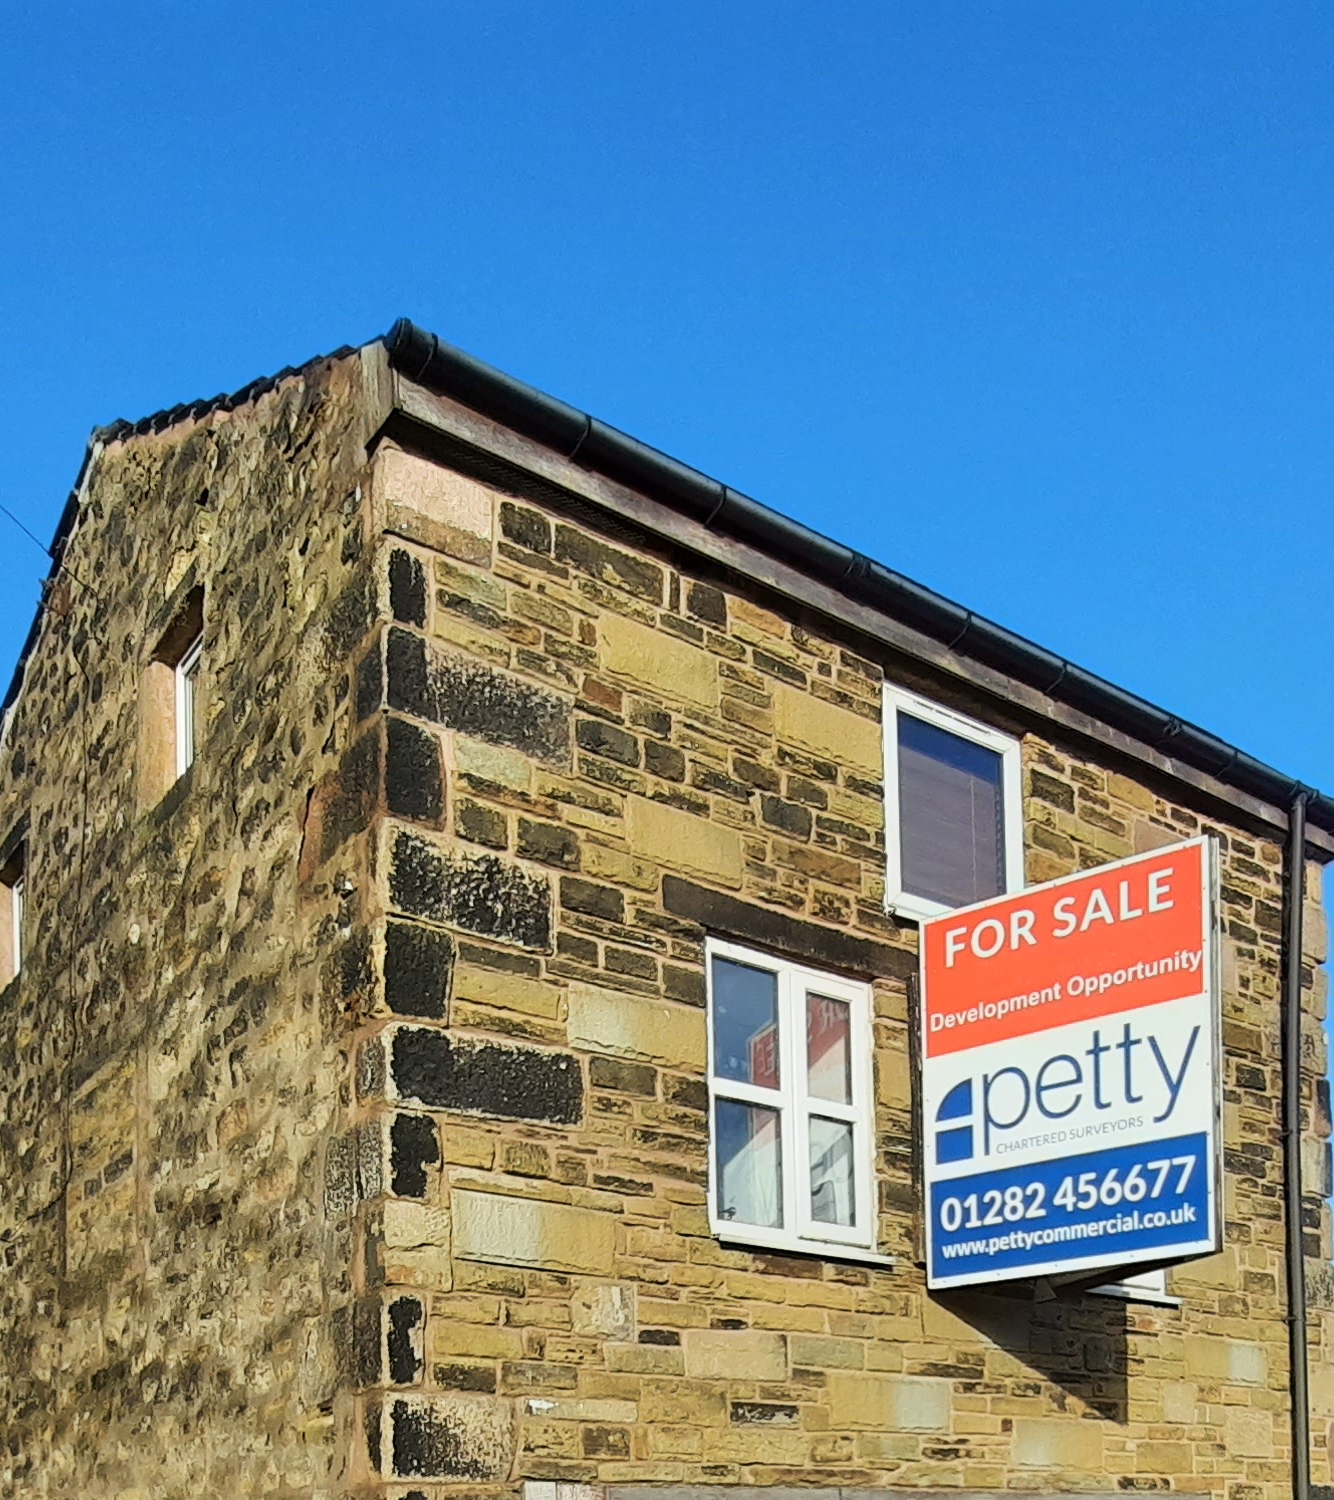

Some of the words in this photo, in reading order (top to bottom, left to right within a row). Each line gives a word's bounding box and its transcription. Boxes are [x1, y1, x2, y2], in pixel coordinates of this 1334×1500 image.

[944, 909, 1037, 968] FOR
[1052, 867, 1175, 938] SALE
[930, 982, 1062, 1033] Development
[1067, 947, 1203, 998] Opportunity
[982, 1023, 1201, 1156] petty
[996, 1129, 1067, 1155] CHARTERED
[1069, 1116, 1144, 1141] SURVEYORS
[940, 1182, 1046, 1232] 01282
[1053, 1155, 1197, 1212] 456677
[942, 1203, 1196, 1259] www.pettycommercial.co.uk
